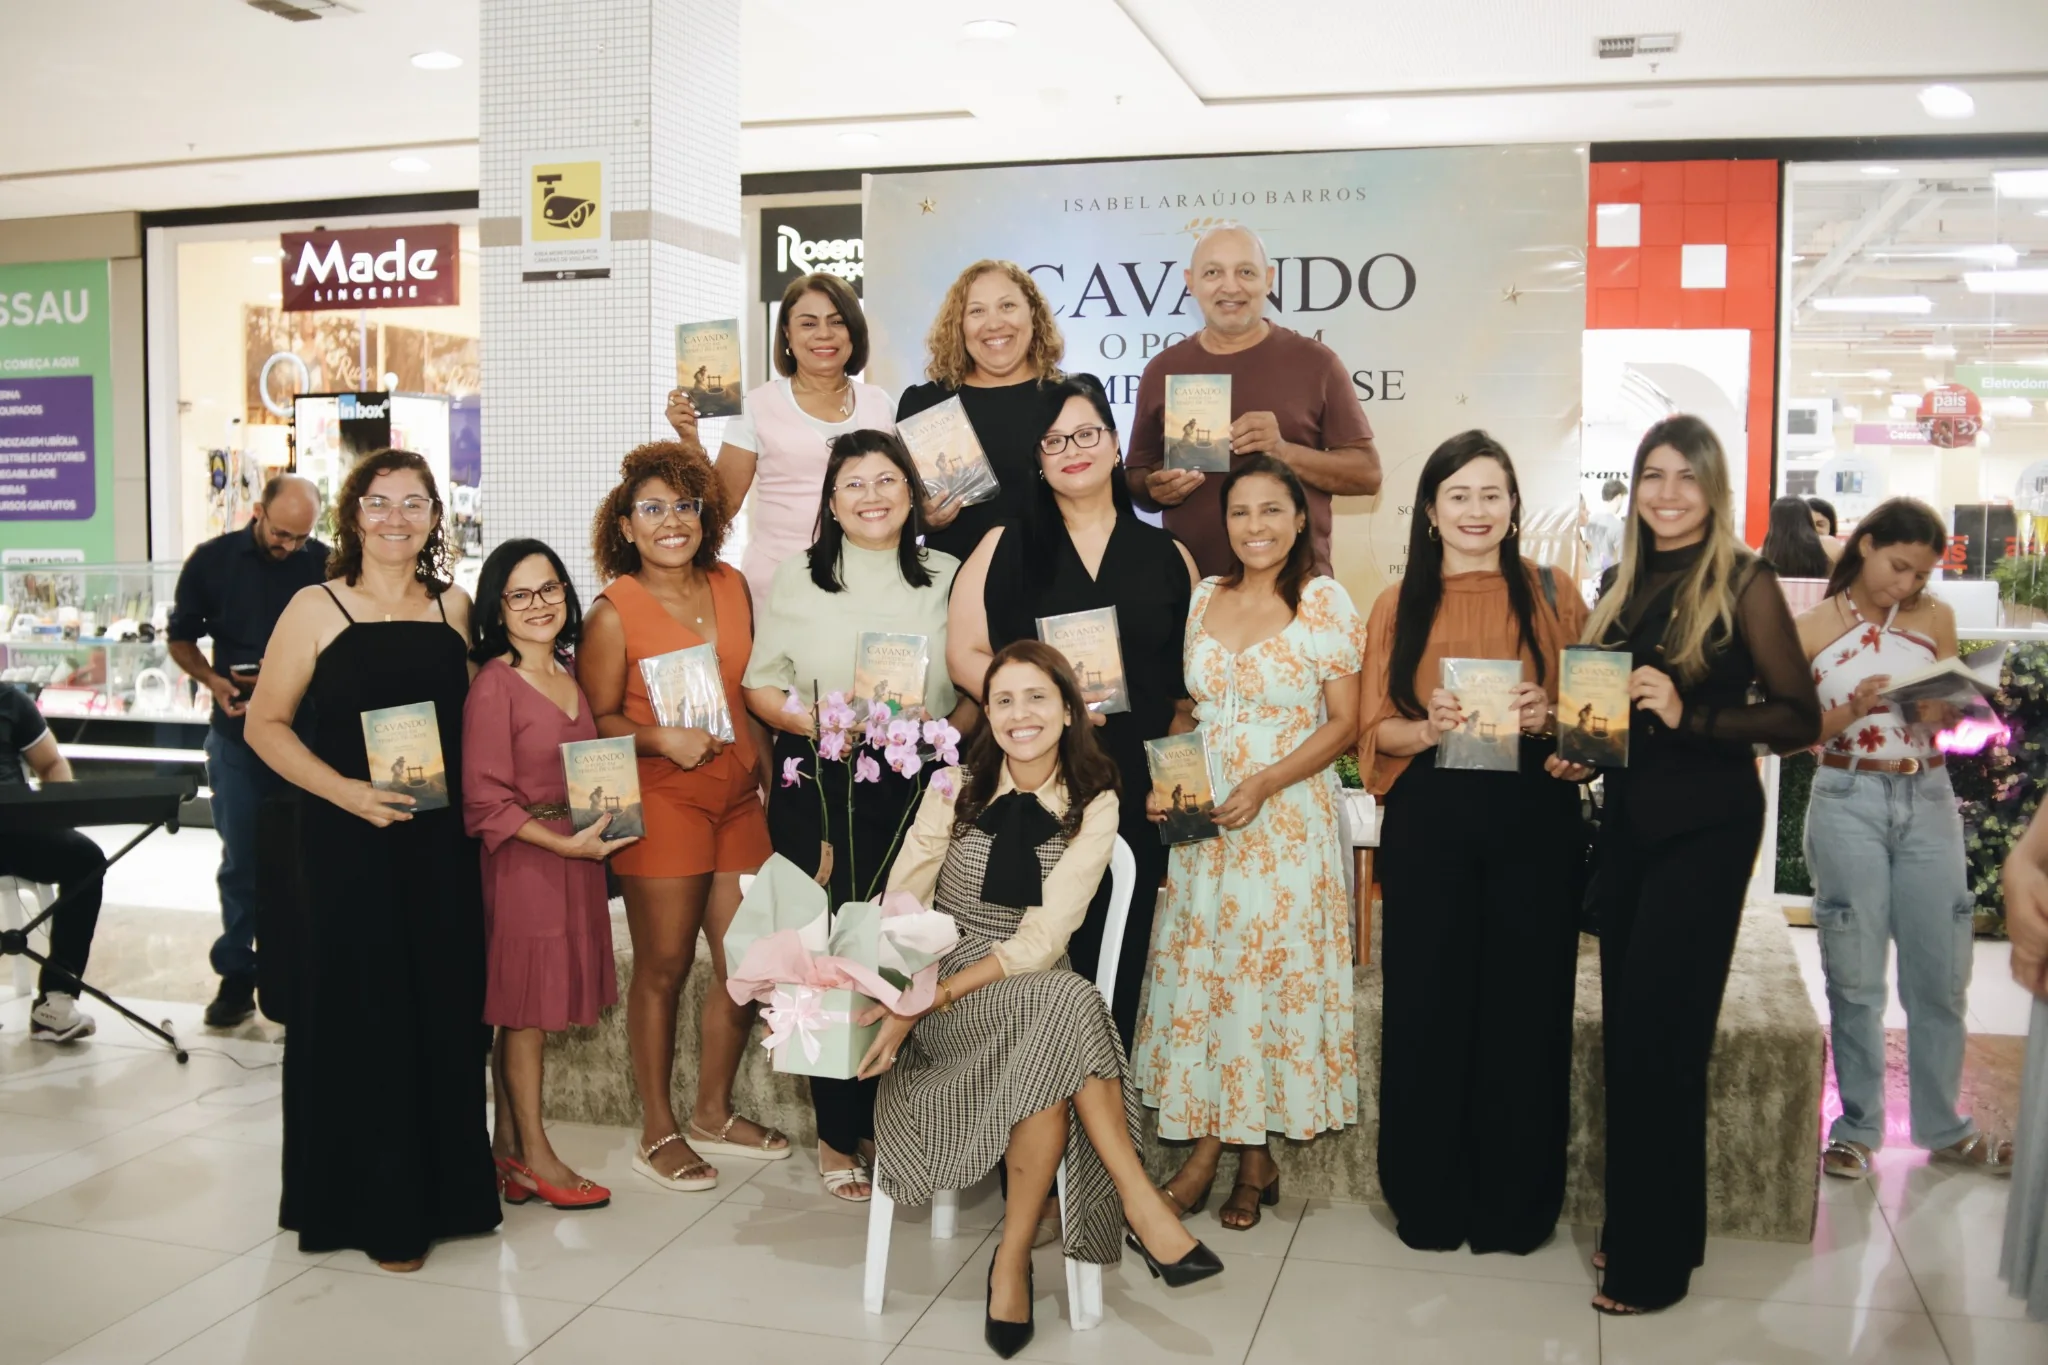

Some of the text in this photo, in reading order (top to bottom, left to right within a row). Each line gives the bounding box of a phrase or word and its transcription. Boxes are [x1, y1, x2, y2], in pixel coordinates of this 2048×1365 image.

[1063, 187, 1367, 212] ISABEL ARAÚJO BARROS
[294, 238, 438, 286] Made
[314, 285, 418, 302] LINGERIE
[683, 332, 729, 345] CAVANDO
[1099, 333, 1127, 359] O
[374, 719, 427, 733] CAVANDO
[574, 752, 625, 765] CAVANDO
